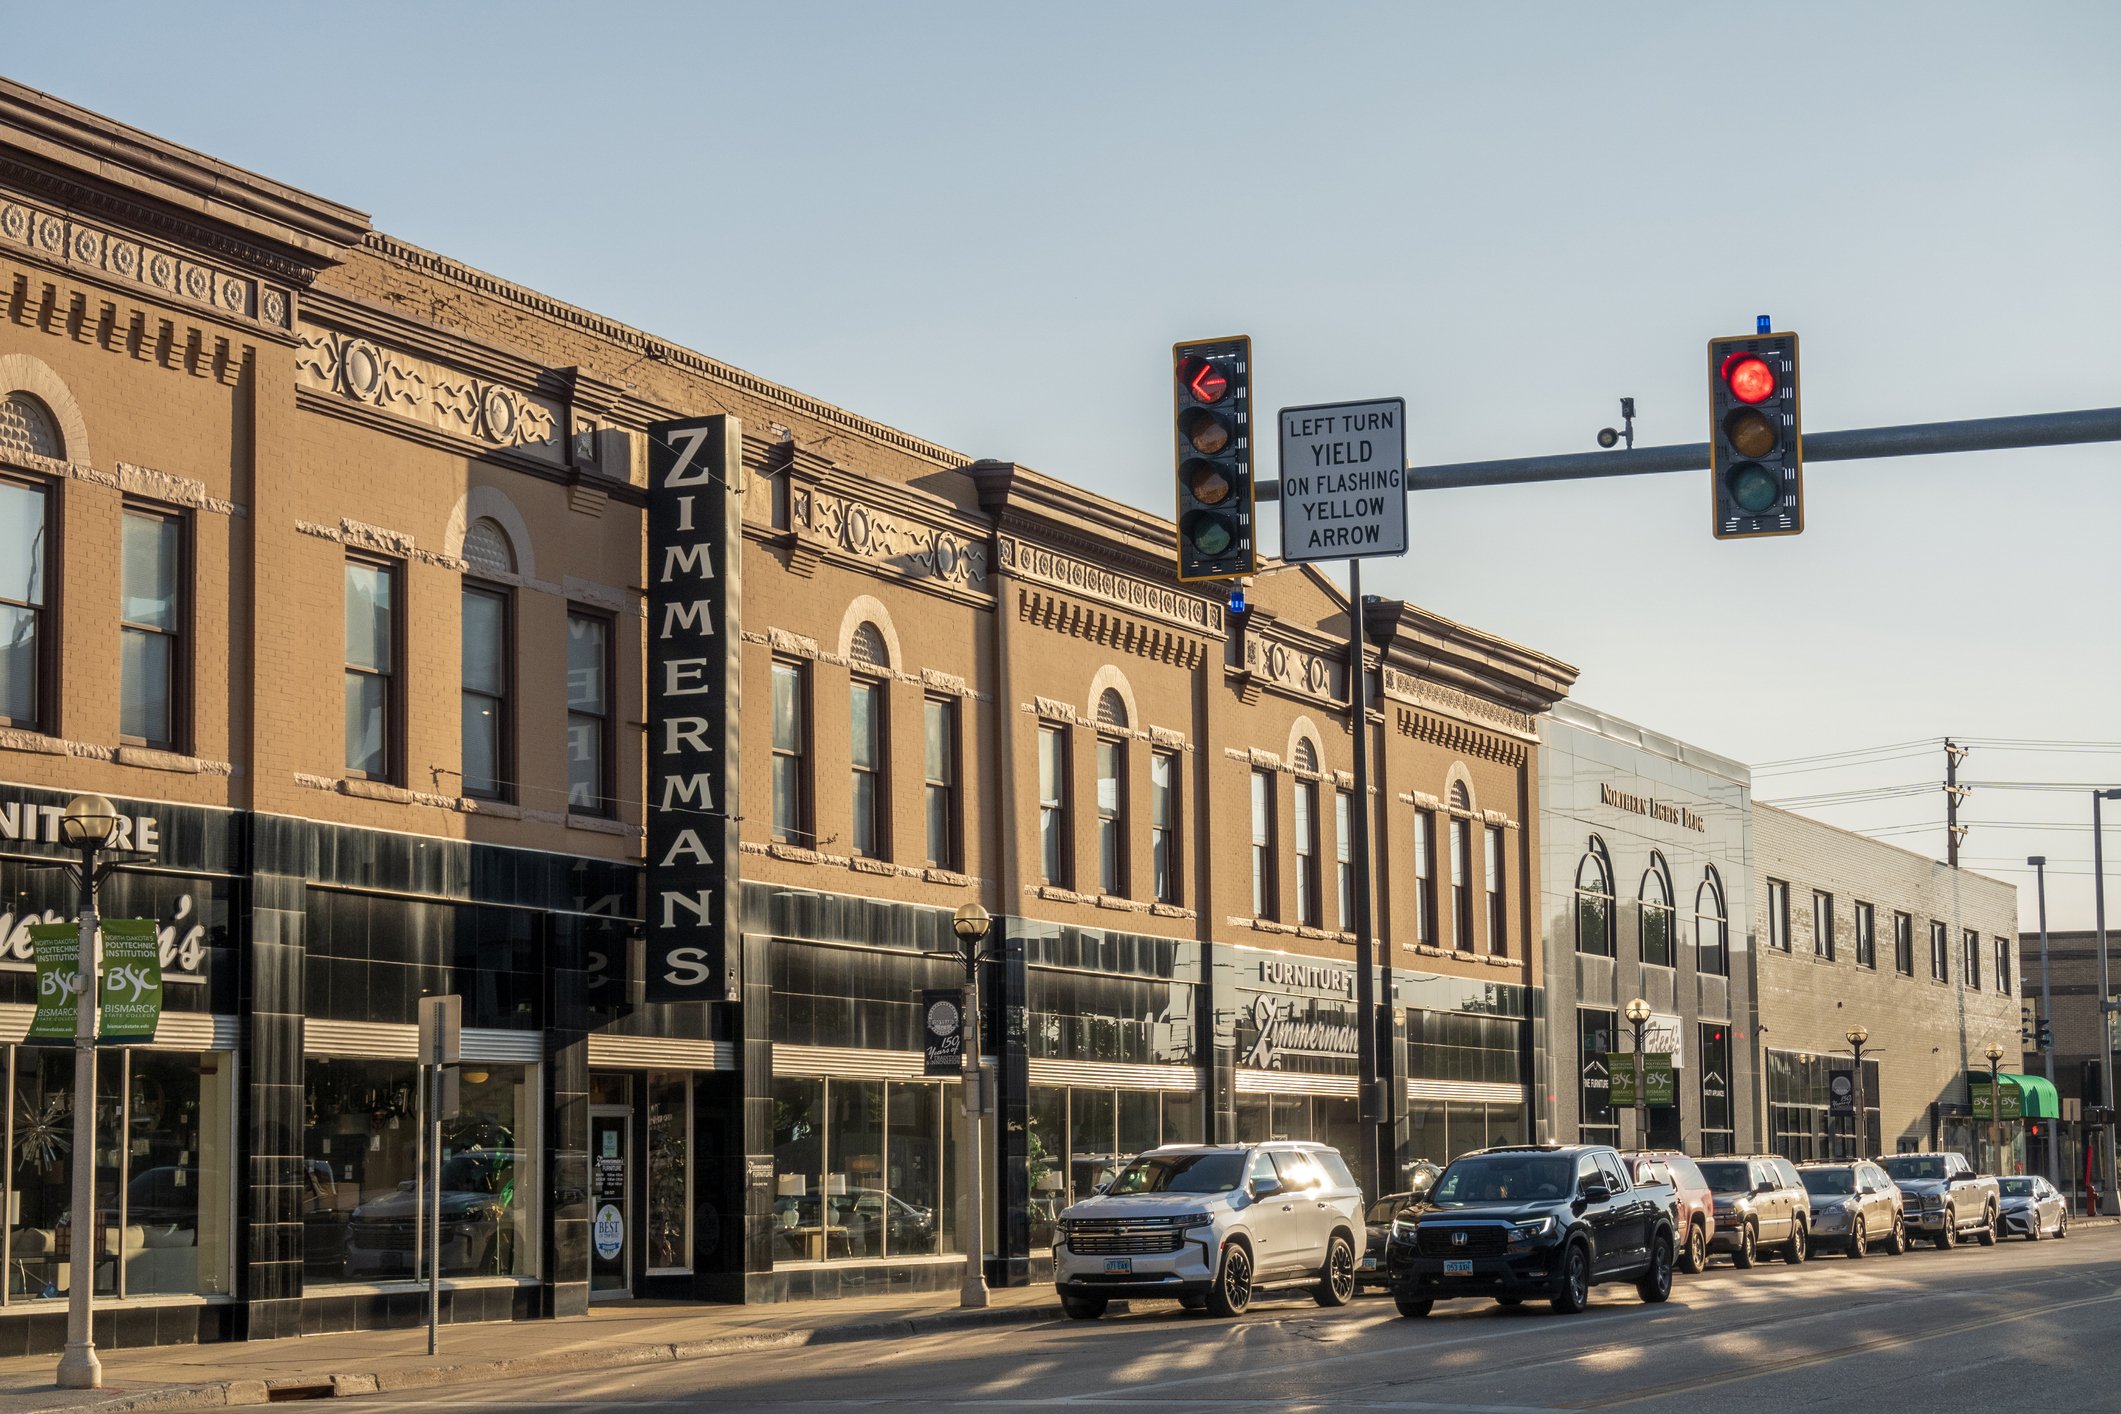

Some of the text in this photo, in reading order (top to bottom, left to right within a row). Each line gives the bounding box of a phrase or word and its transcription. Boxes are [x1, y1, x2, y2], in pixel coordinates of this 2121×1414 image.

[1290, 412, 1394, 437] LEFT TURN
[1311, 440, 1373, 466] YIELD
[1287, 470, 1400, 498] ON FLASHING
[1302, 497, 1385, 522] YELLOW
[1308, 524, 1380, 548] ARROW
[658, 426, 715, 987] ZIMMERMANS
[0, 801, 160, 853] NITRE
[36, 945, 80, 954] POLYTECHNIC
[106, 942, 156, 950] POLYTECHNIC
[106, 950, 156, 958] INSTITUTION
[38, 954, 80, 962] INSTITUTION
[106, 963, 158, 1003] BSC
[1262, 960, 1350, 991] FURNITURE
[38, 1007, 78, 1017] BISMARCK
[104, 1004, 156, 1013] BISMARCK
[942, 1034, 960, 1048] 150
[926, 1046, 950, 1060] Years
[599, 1221, 620, 1233] BEST
